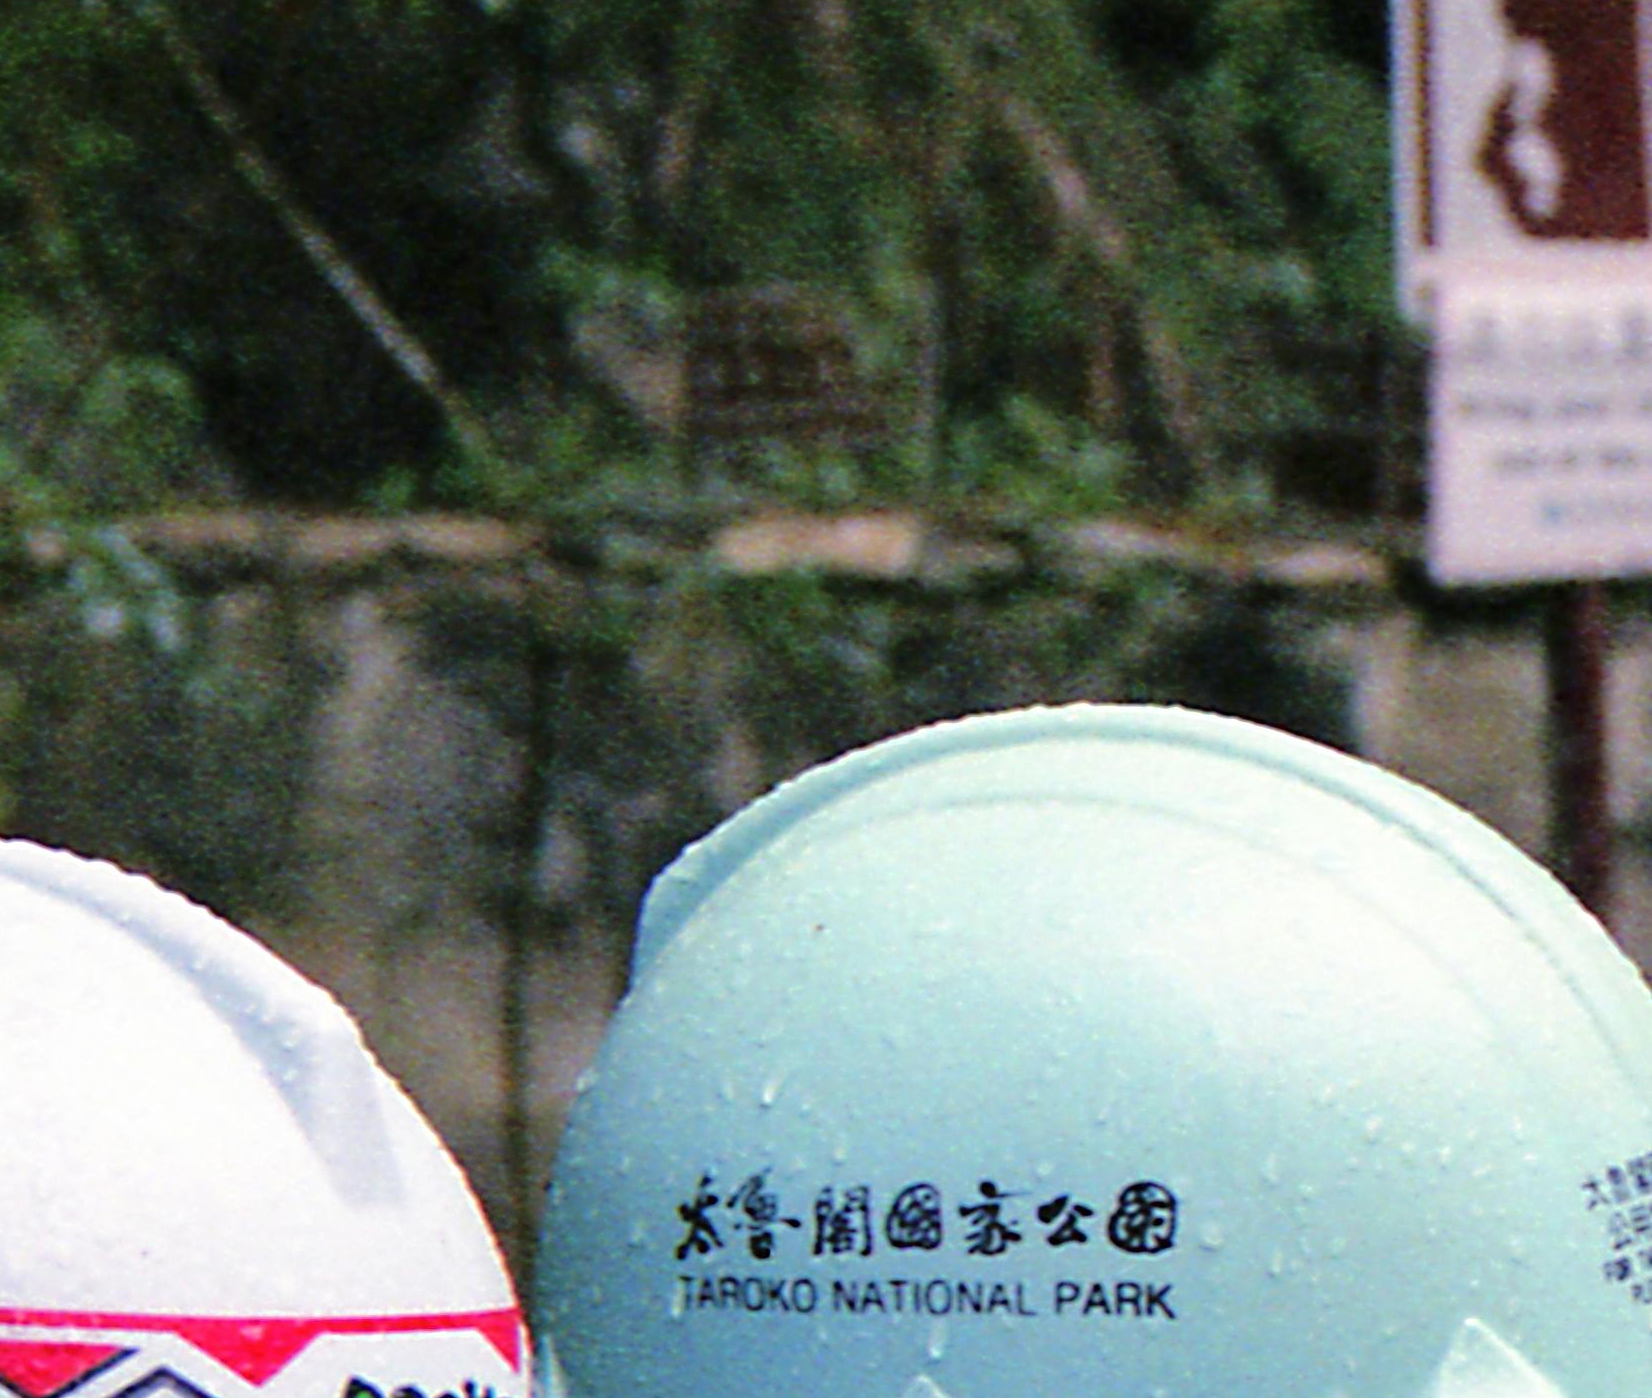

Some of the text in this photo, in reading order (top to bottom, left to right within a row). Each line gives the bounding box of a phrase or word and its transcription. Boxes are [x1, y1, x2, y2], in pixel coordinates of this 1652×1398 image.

[676, 1167, 1178, 1259] 太魯閣國家公園
[679, 1275, 1176, 1320] TAROKO NATIONAL PARK
